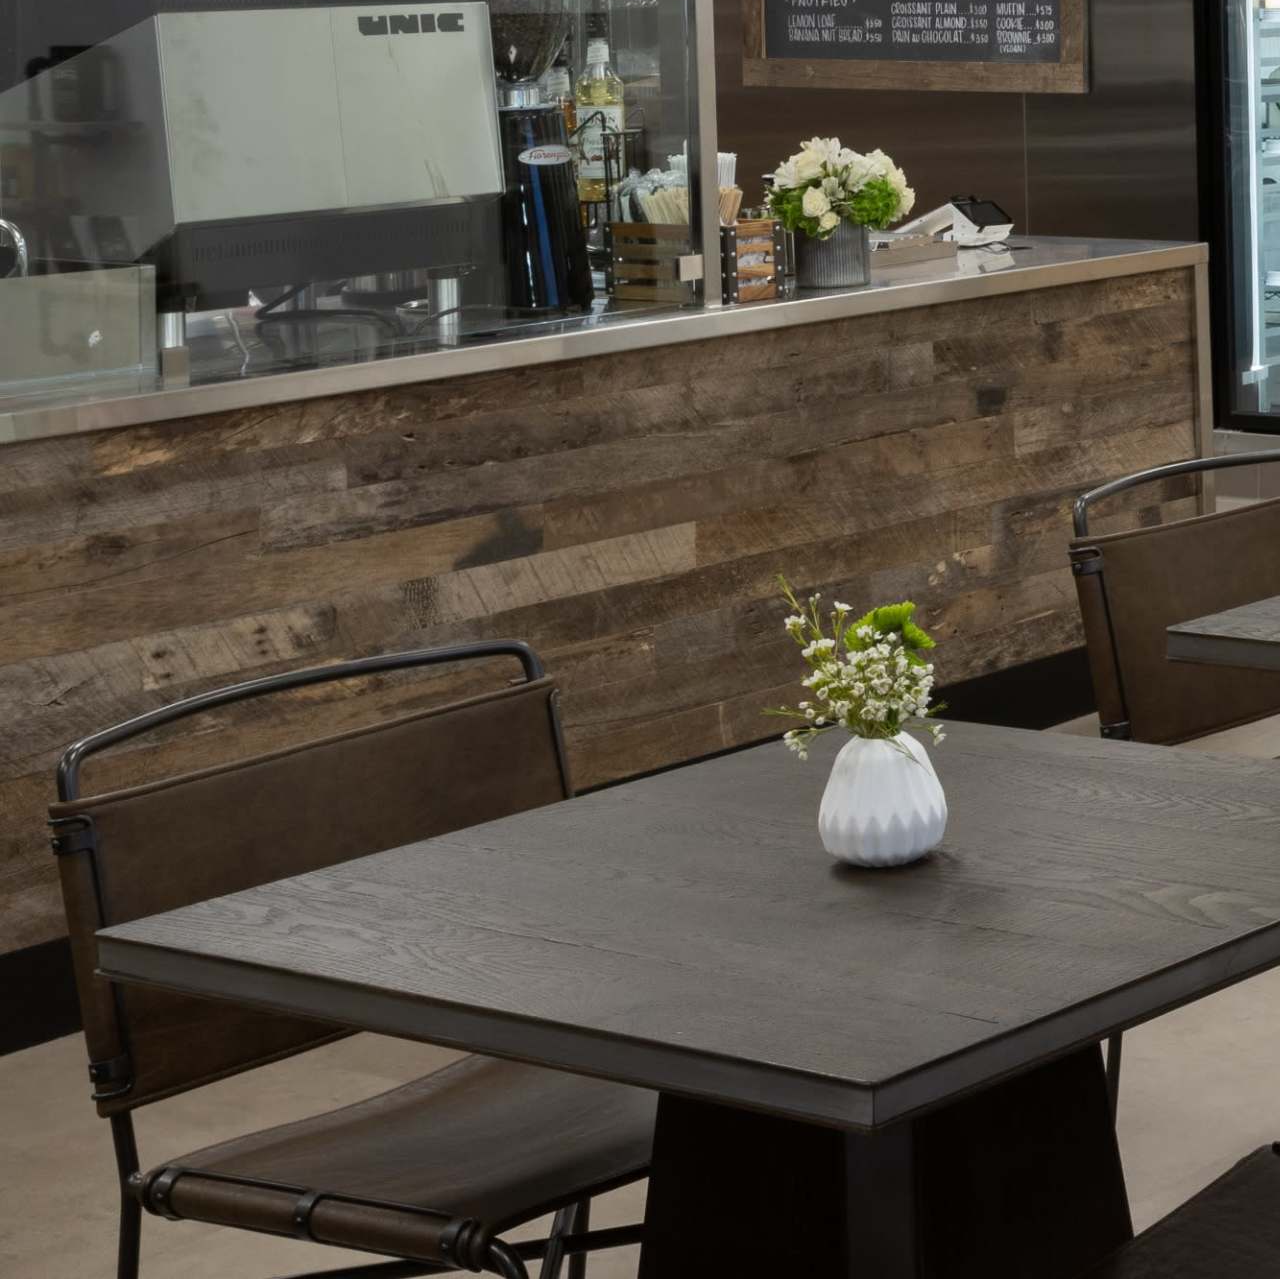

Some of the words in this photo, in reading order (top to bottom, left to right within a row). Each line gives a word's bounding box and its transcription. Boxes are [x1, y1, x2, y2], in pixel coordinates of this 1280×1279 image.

[890, 1, 932, 15] CROISSANT
[935, 1, 957, 15] PLAIN
[996, 1, 1026, 16] MUFFIN
[357, 13, 465, 36] UNIC
[787, 13, 816, 28] LEMON
[891, 16, 932, 30] CROISSANT
[934, 16, 967, 30] ALMOND
[996, 17, 1025, 31] COOKIE
[821, 27, 836, 42] NUT
[892, 29, 911, 44] PAIN
[921, 29, 964, 44] CHOCOLAT
[997, 30, 1032, 45] BROWNIE
